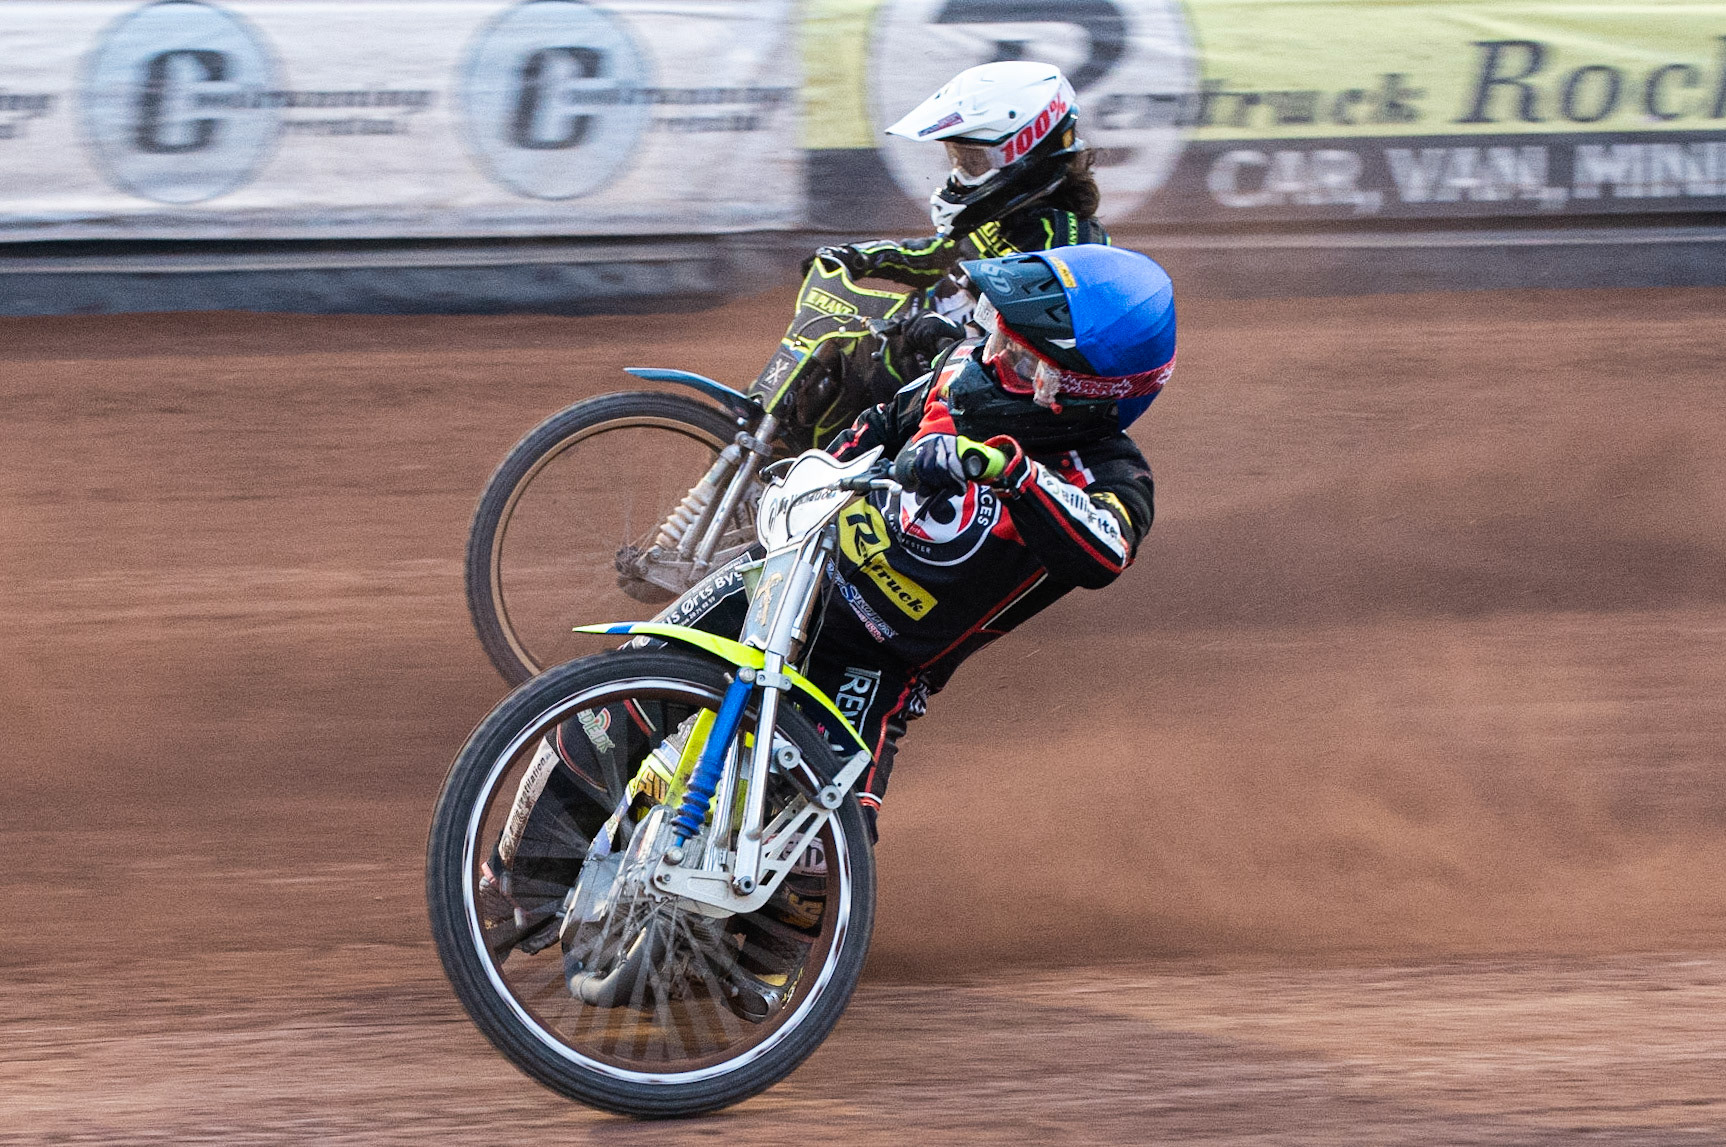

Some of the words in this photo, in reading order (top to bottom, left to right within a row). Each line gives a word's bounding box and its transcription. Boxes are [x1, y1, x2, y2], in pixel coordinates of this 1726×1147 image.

[1000, 93, 1067, 164] 100%
[977, 484, 994, 527] ACES
[681, 584, 714, 615] Ørts
